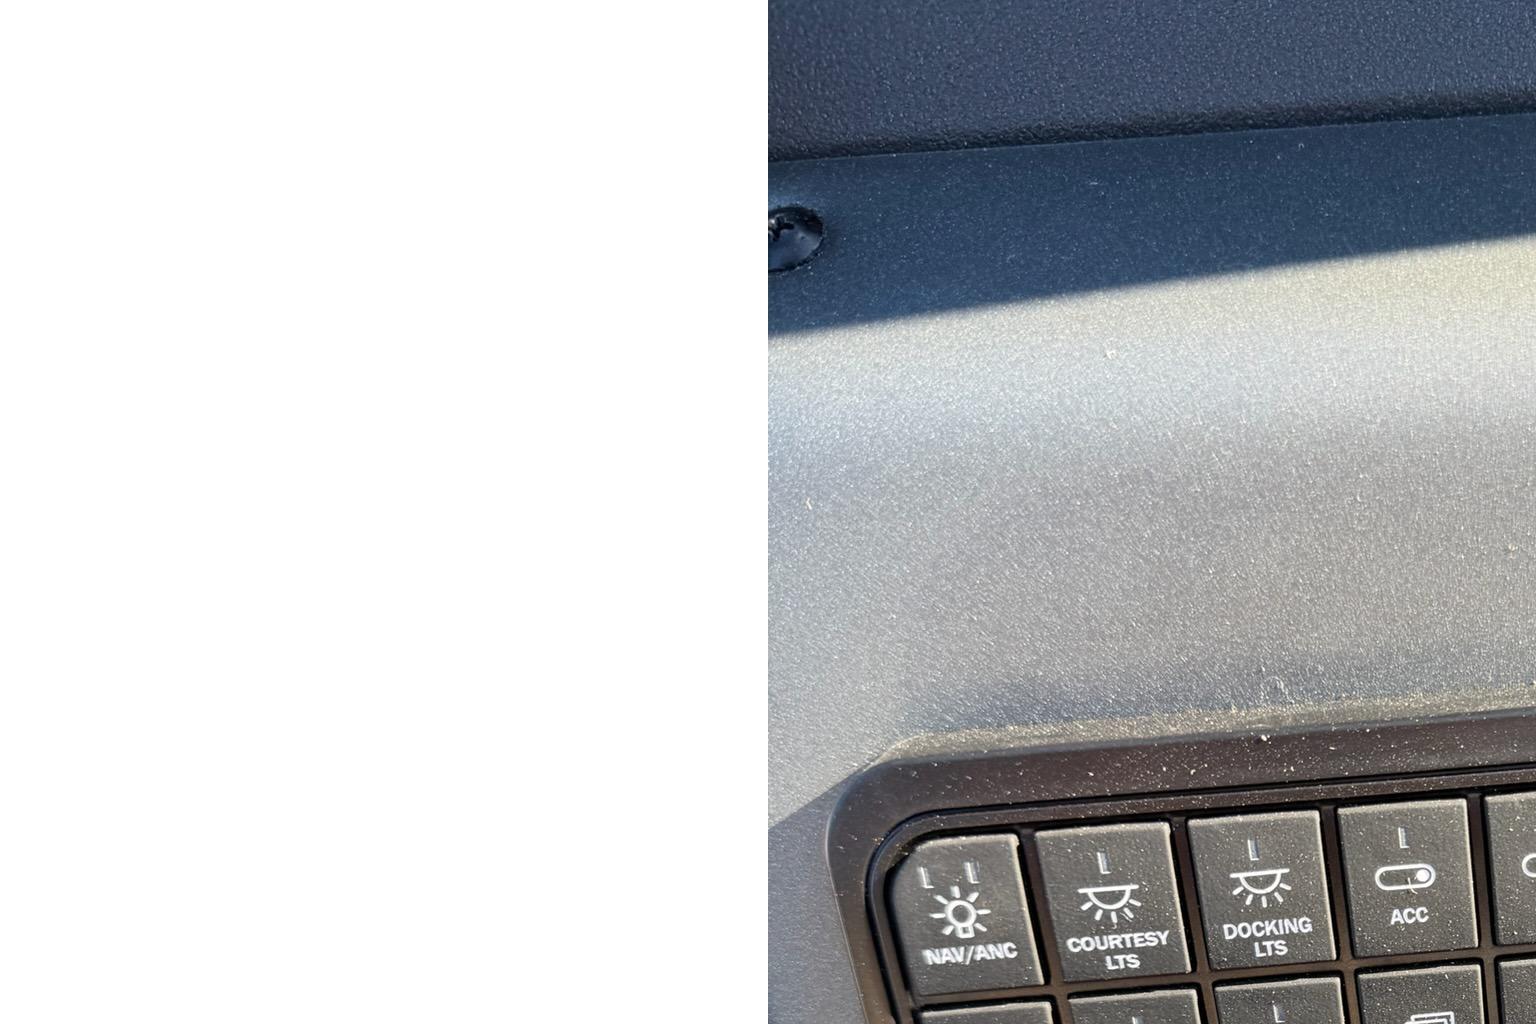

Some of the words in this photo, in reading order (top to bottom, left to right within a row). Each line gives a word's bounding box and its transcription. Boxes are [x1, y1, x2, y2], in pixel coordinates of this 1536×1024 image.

[1390, 906, 1430, 925] ACC
[1223, 917, 1313, 940] DOCKING
[1066, 930, 1170, 954] COURTESY
[1254, 940, 1288, 957] LTS
[921, 942, 1018, 966] NAV/ANC
[1105, 954, 1140, 970] LTS
